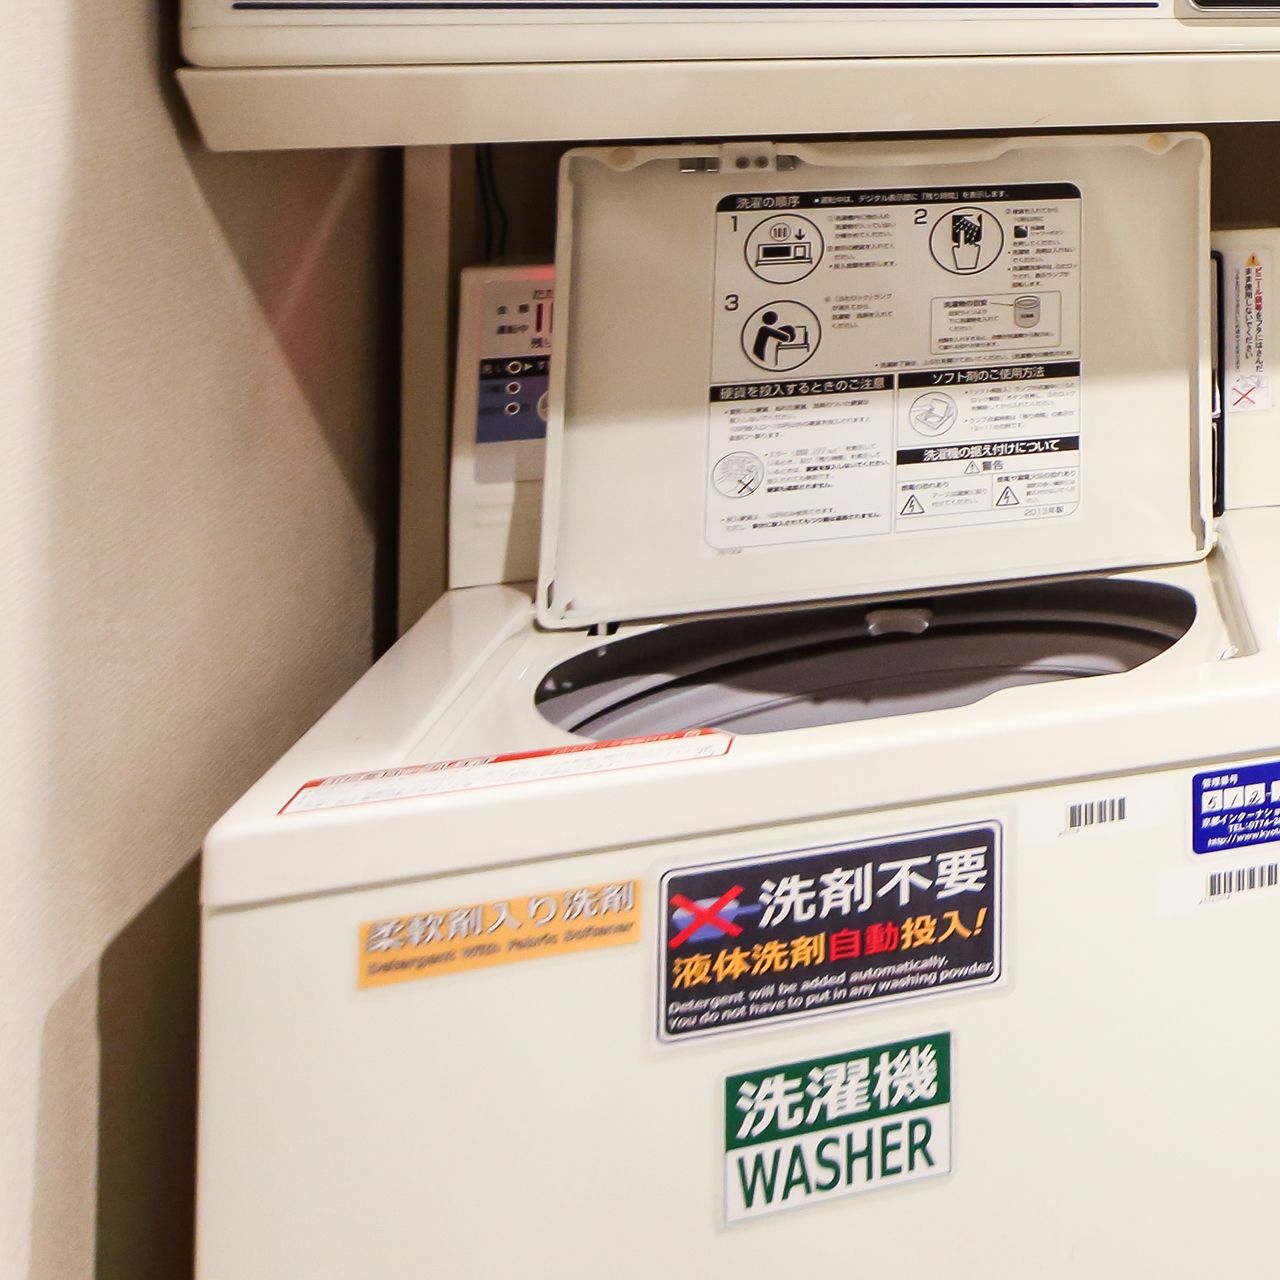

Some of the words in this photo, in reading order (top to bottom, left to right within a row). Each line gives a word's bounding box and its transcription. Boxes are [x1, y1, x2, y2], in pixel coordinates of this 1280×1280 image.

[913, 208, 929, 225] 2
[724, 294, 740, 311] 3
[366, 880, 636, 954] 柔軟剤入り洗剤
[758, 845, 988, 930] 洗剤不要
[668, 991, 746, 1016] Detergent
[750, 984, 775, 1002] will
[779, 981, 797, 996] be
[800, 972, 846, 993] added
[670, 1012, 698, 1031] You
[700, 1010, 720, 1025] do
[721, 1005, 746, 1021] not
[749, 1000, 785, 1017] have
[787, 996, 804, 1010] to
[806, 991, 831, 1010] put
[833, 988, 847, 1000] in
[850, 983, 877, 1000] any
[878, 971, 937, 993] washing
[736, 1043, 938, 1140] 洗濯機
[737, 1117, 935, 1210] WASHER
